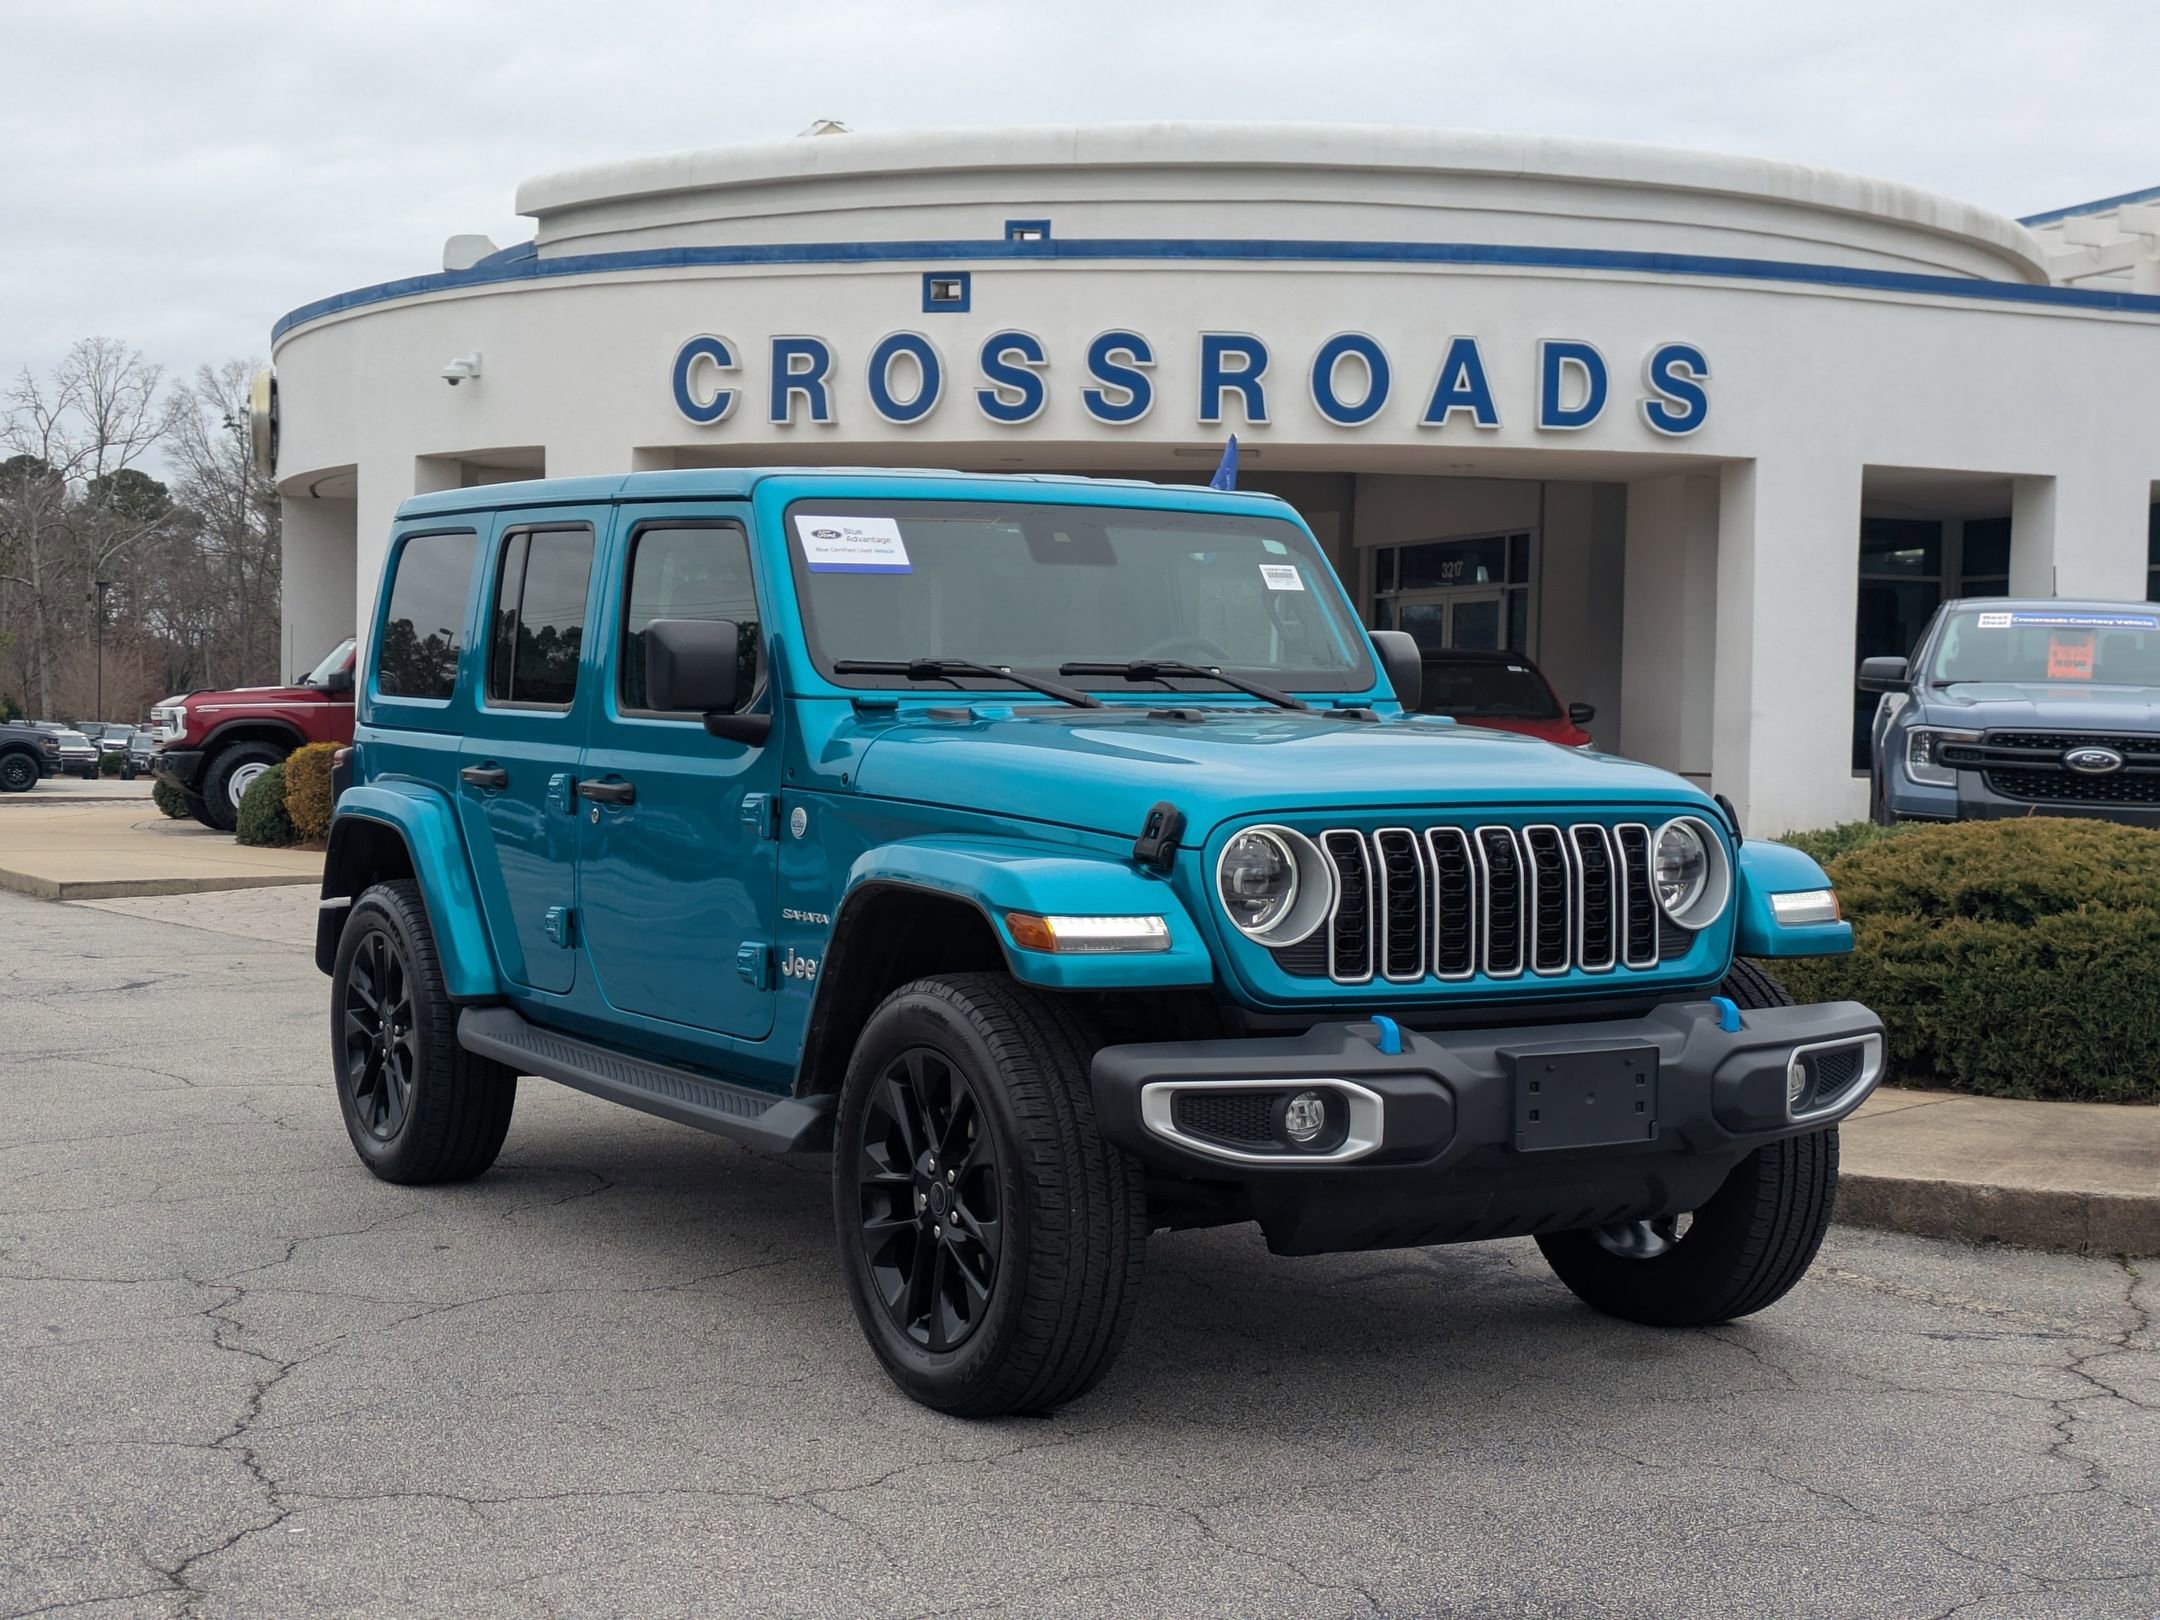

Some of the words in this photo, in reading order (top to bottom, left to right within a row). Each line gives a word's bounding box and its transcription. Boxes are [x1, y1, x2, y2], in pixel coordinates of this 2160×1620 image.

[671, 328, 1711, 437] CROSSROADS
[847, 536, 891, 544] Advantage
[1441, 561, 1463, 578] 3217
[2071, 618, 2113, 626] Courtesy
[782, 908, 830, 924] SAHARA
[782, 948, 819, 981] Jee
